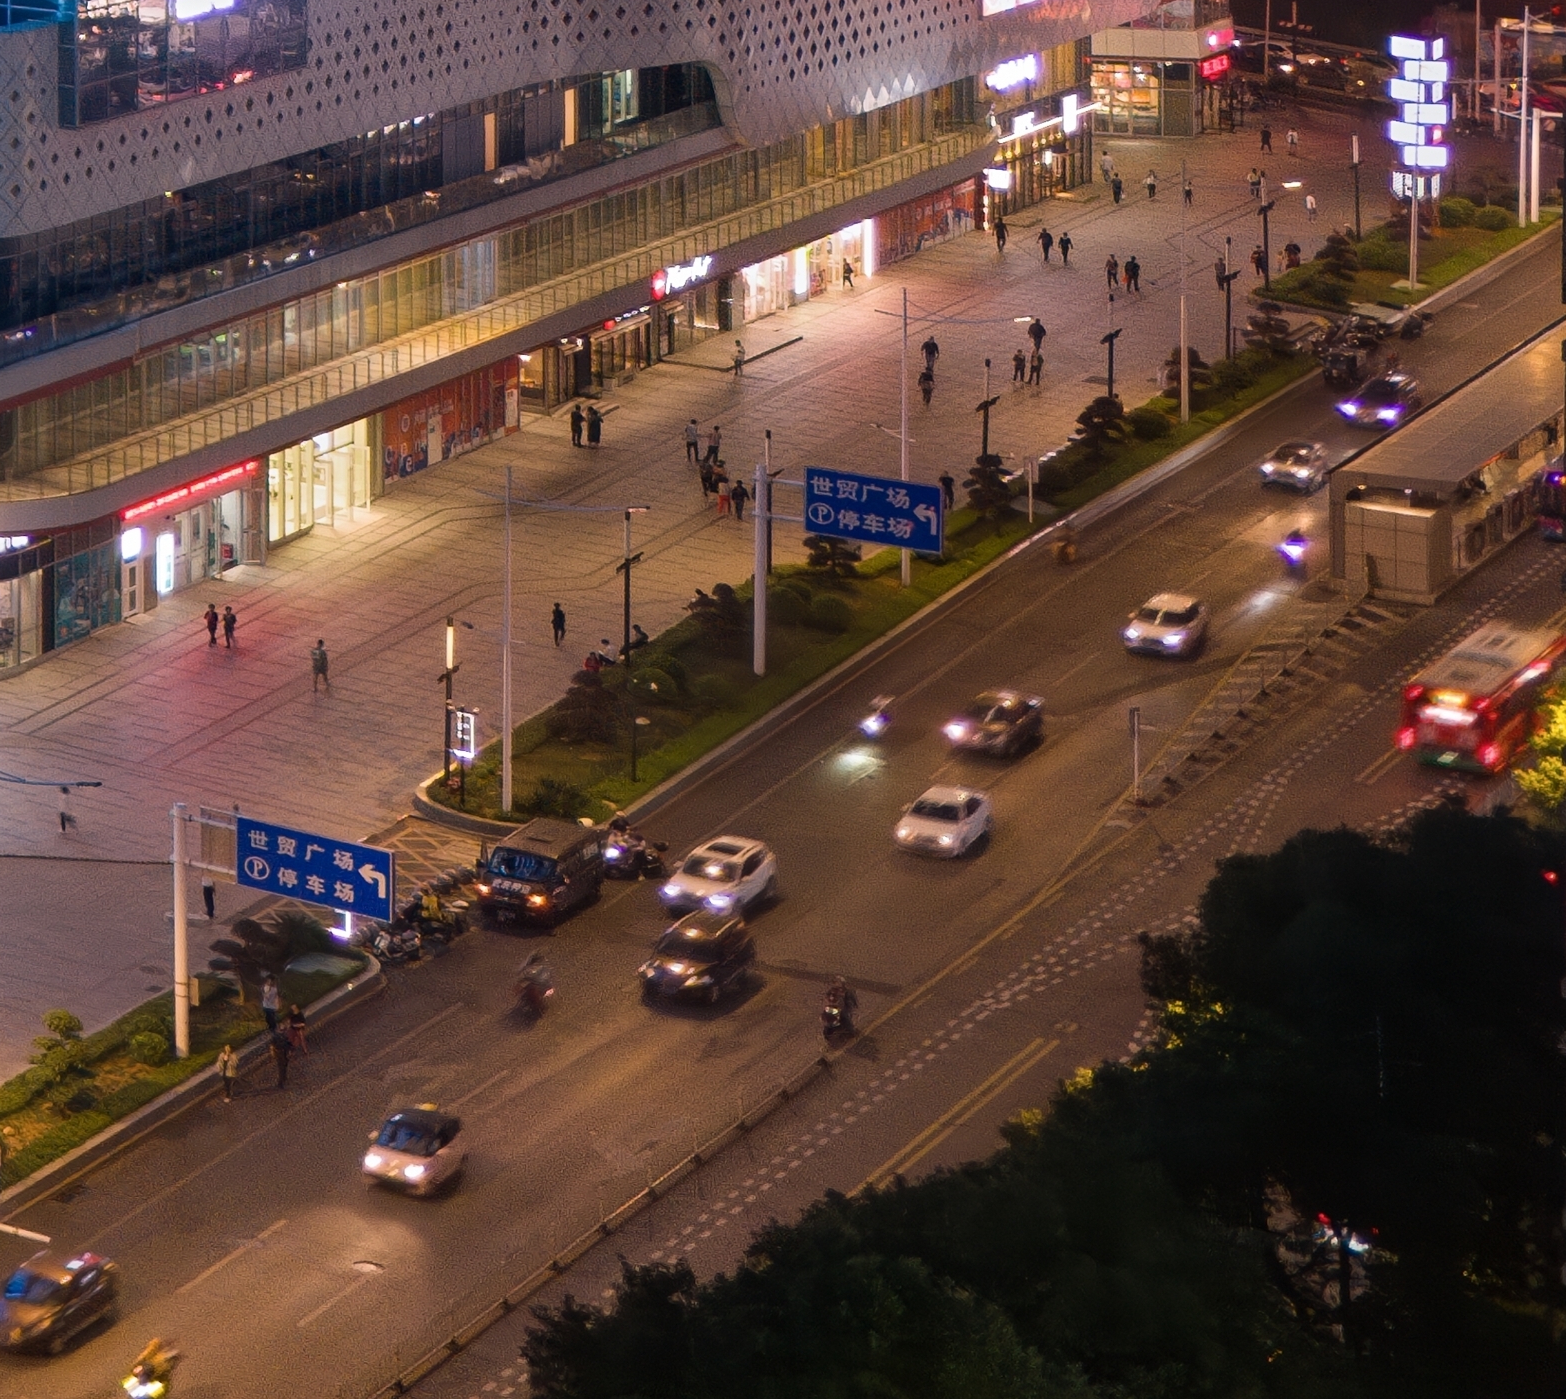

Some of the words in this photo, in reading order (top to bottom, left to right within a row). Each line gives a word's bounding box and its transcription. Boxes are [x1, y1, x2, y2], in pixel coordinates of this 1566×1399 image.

[810, 475, 911, 511] 世贸广场
[837, 510, 914, 540] 停车场
[247, 829, 355, 873] 世贸广场
[277, 866, 355, 904] 停车场
